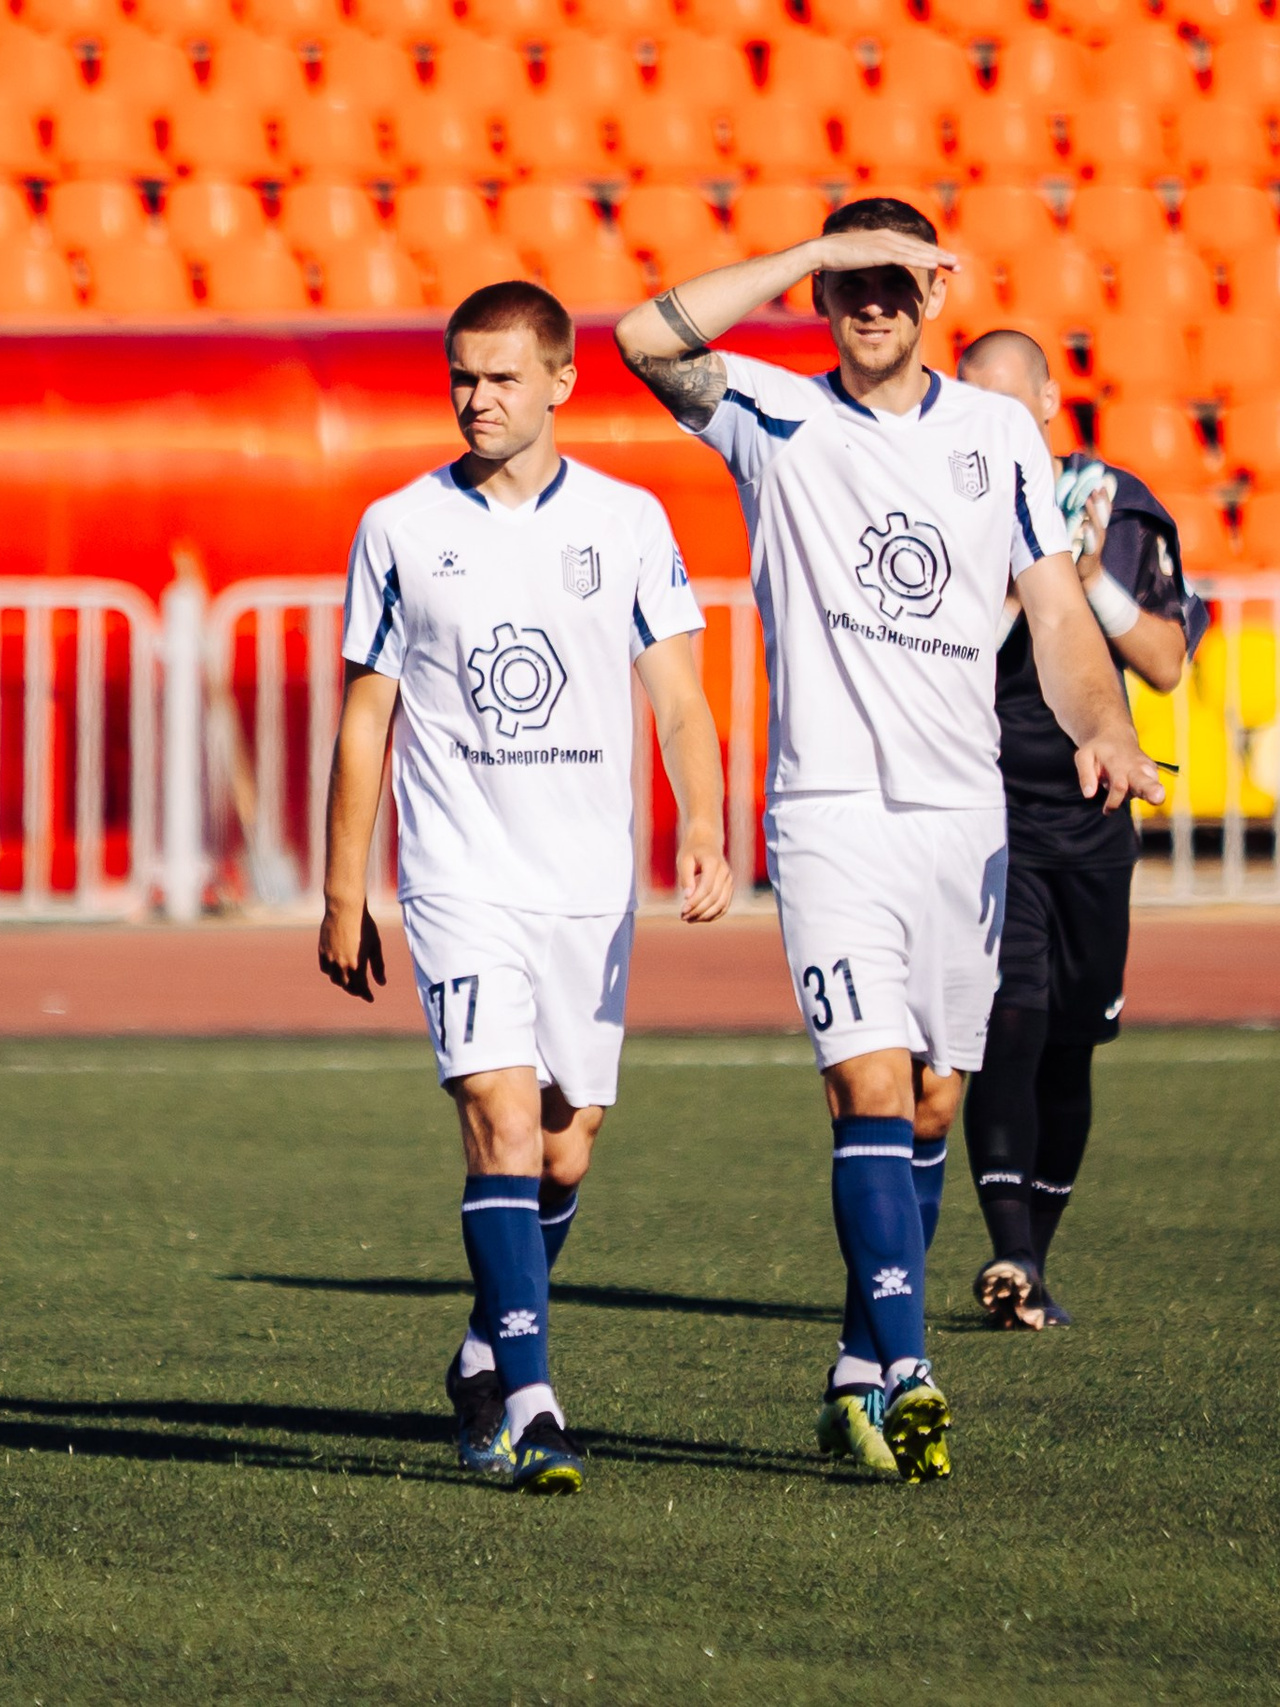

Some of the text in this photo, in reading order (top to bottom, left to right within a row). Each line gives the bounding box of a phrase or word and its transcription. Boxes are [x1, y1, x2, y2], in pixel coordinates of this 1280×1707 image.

[432, 568, 467, 578] KELME
[803, 957, 863, 1032] 31
[428, 974, 479, 1053] 77
[873, 1284, 912, 1300] KELME
[499, 1325, 539, 1339] KELME
